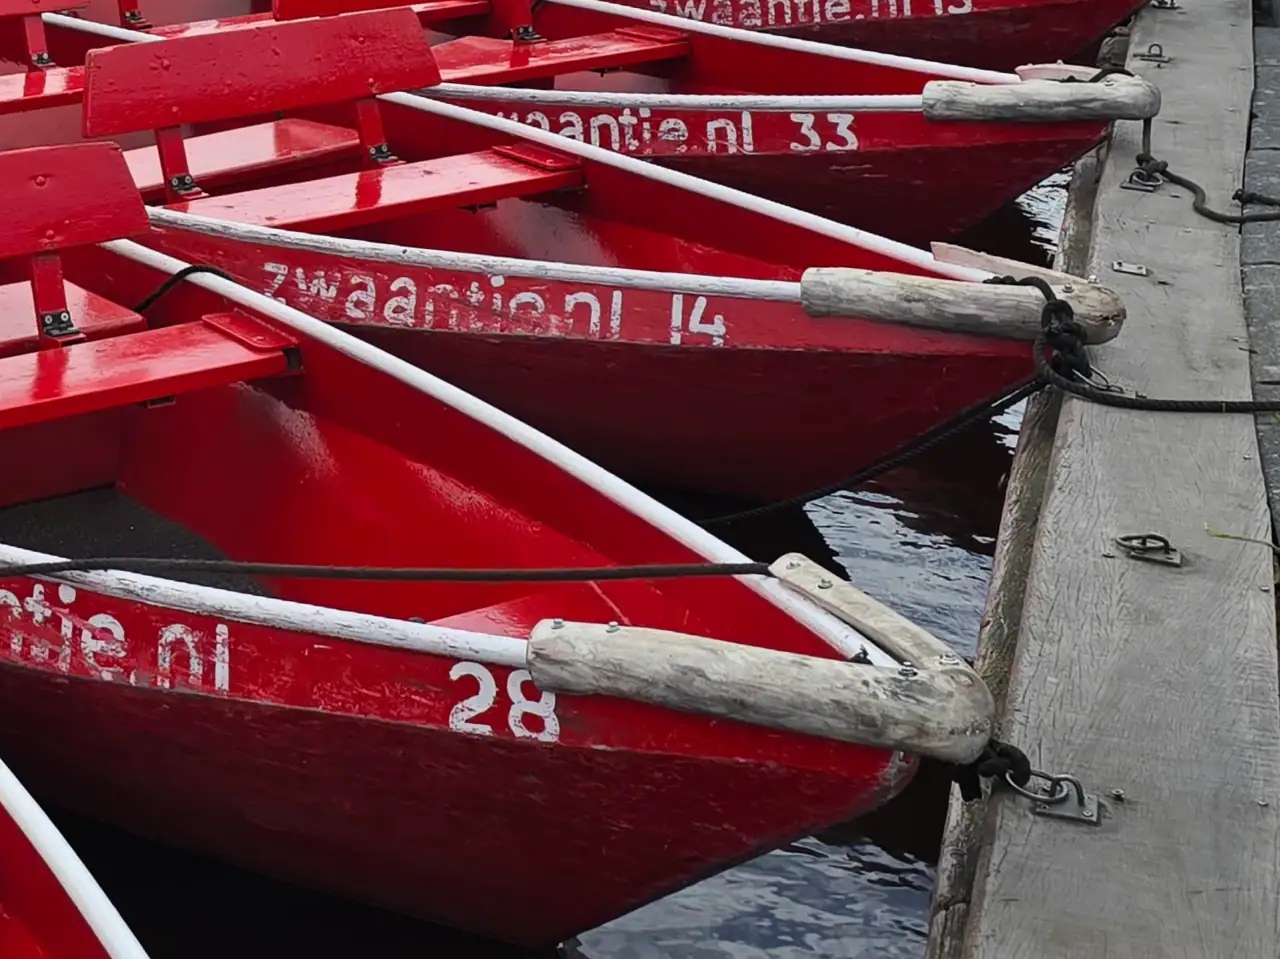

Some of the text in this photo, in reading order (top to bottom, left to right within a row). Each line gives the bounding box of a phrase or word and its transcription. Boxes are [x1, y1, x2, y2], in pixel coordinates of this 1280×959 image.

[790, 113, 859, 152] 33
[671, 293, 725, 346] 14
[449, 661, 560, 742] 28
